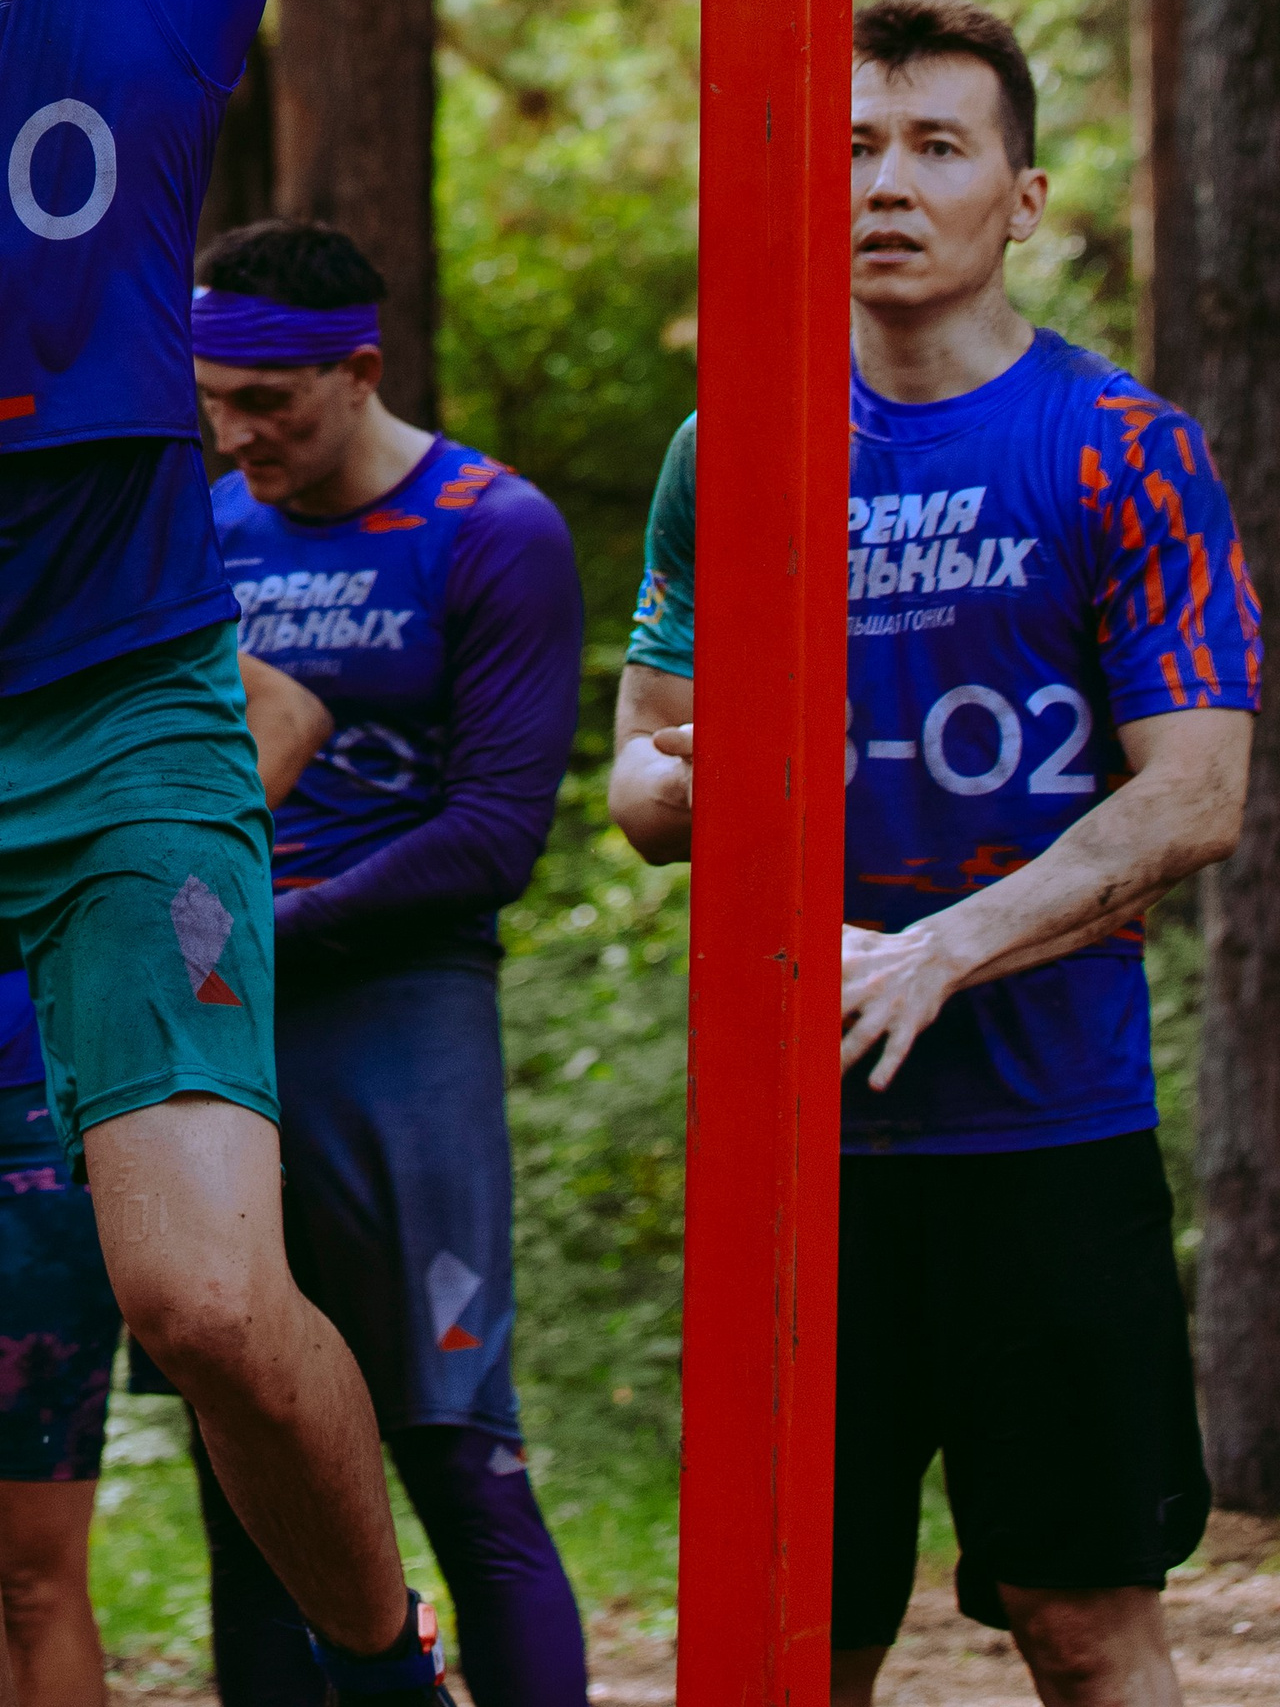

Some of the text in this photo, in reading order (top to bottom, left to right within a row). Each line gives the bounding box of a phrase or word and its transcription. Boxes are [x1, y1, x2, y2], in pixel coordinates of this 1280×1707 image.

[847, 486, 987, 544] РЕМЯ
[847, 537, 1039, 600] ЛЬНЫХ
[237, 607, 416, 654] ЛЬНЫХ
